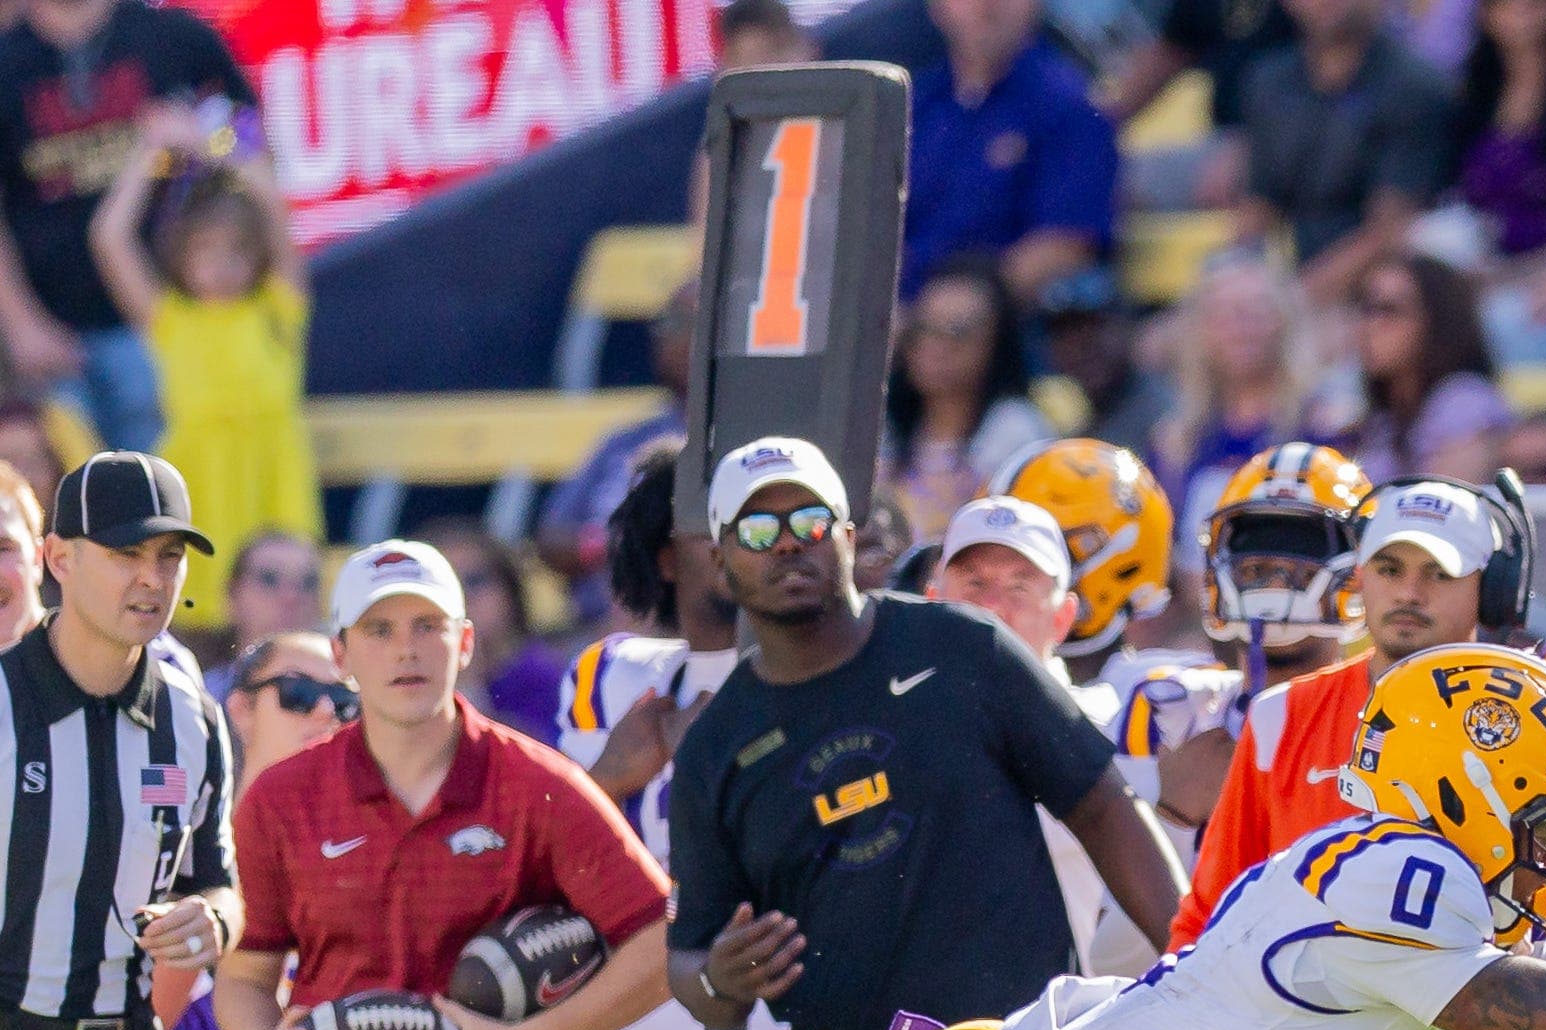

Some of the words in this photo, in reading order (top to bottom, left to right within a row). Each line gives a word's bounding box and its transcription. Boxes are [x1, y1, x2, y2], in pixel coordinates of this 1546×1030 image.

[747, 117, 822, 358] 1
[23, 761, 47, 793] S
[813, 771, 892, 826] LSU
[1390, 855, 1446, 930] 0
